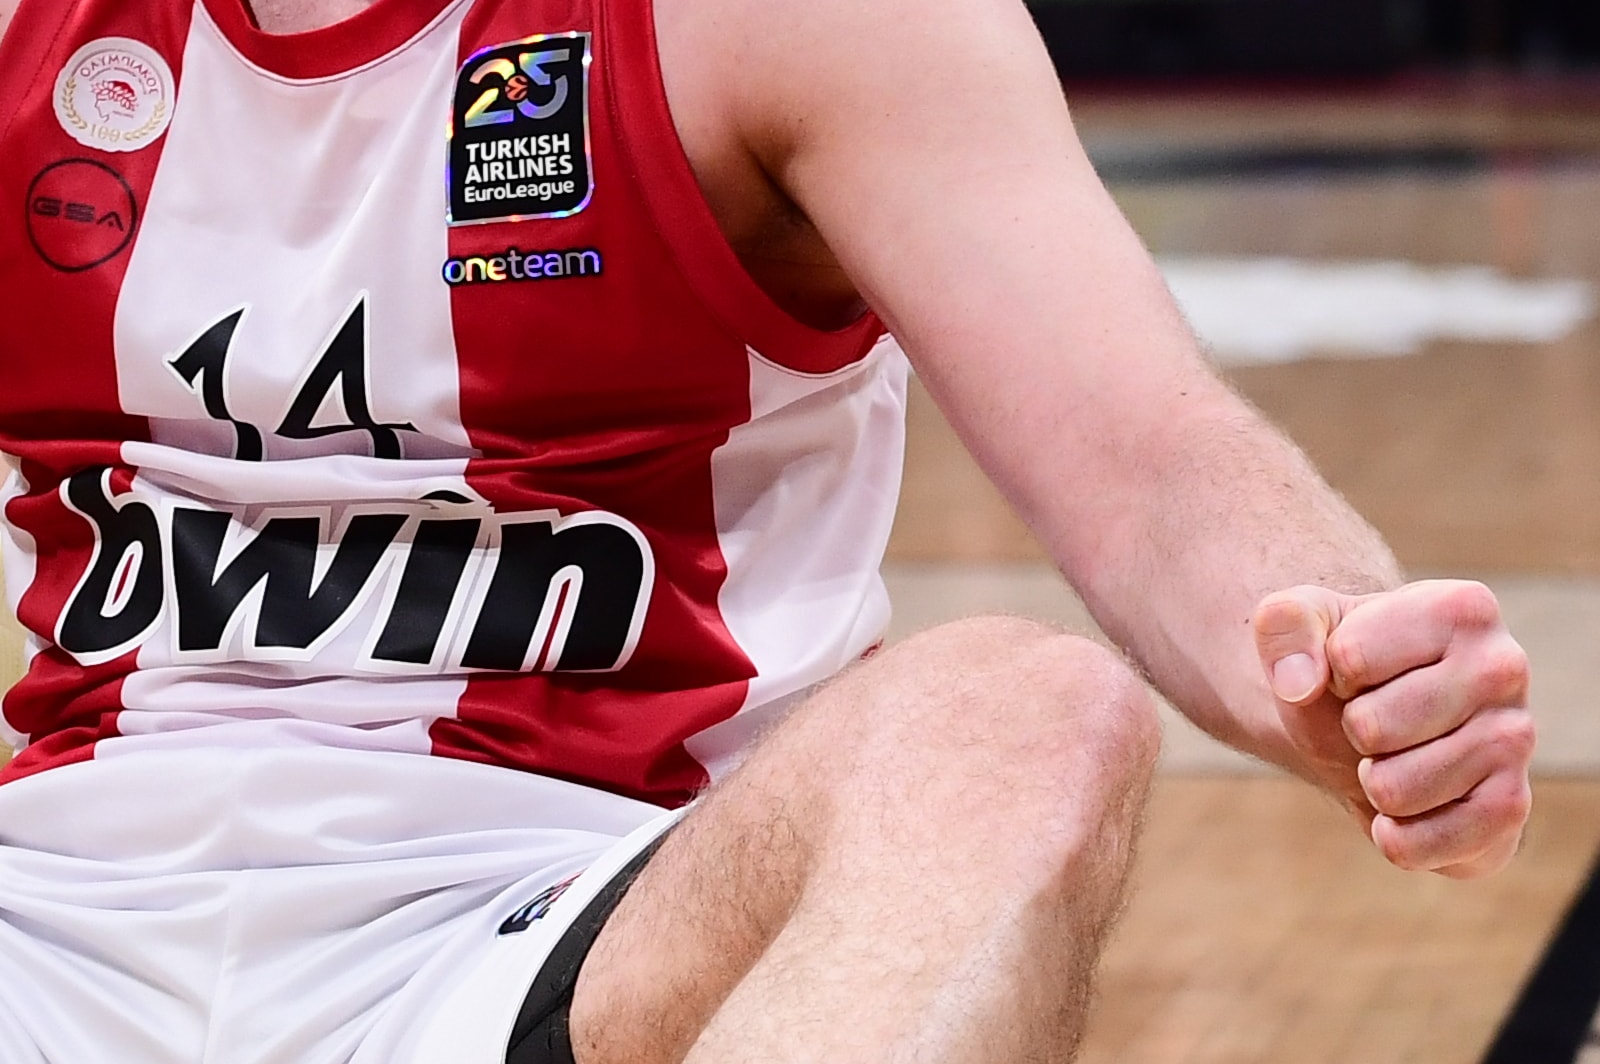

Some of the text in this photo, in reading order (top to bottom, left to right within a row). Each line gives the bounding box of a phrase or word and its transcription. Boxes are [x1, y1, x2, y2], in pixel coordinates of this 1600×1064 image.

[464, 48, 570, 128] 25
[465, 132, 570, 163] TURKISH
[464, 154, 573, 185] AIRLINES
[464, 179, 575, 203] EuroLeague
[33, 197, 124, 232] GSA
[444, 249, 600, 283] oneteam
[165, 294, 421, 460] 14
[57, 464, 650, 673] bwin
